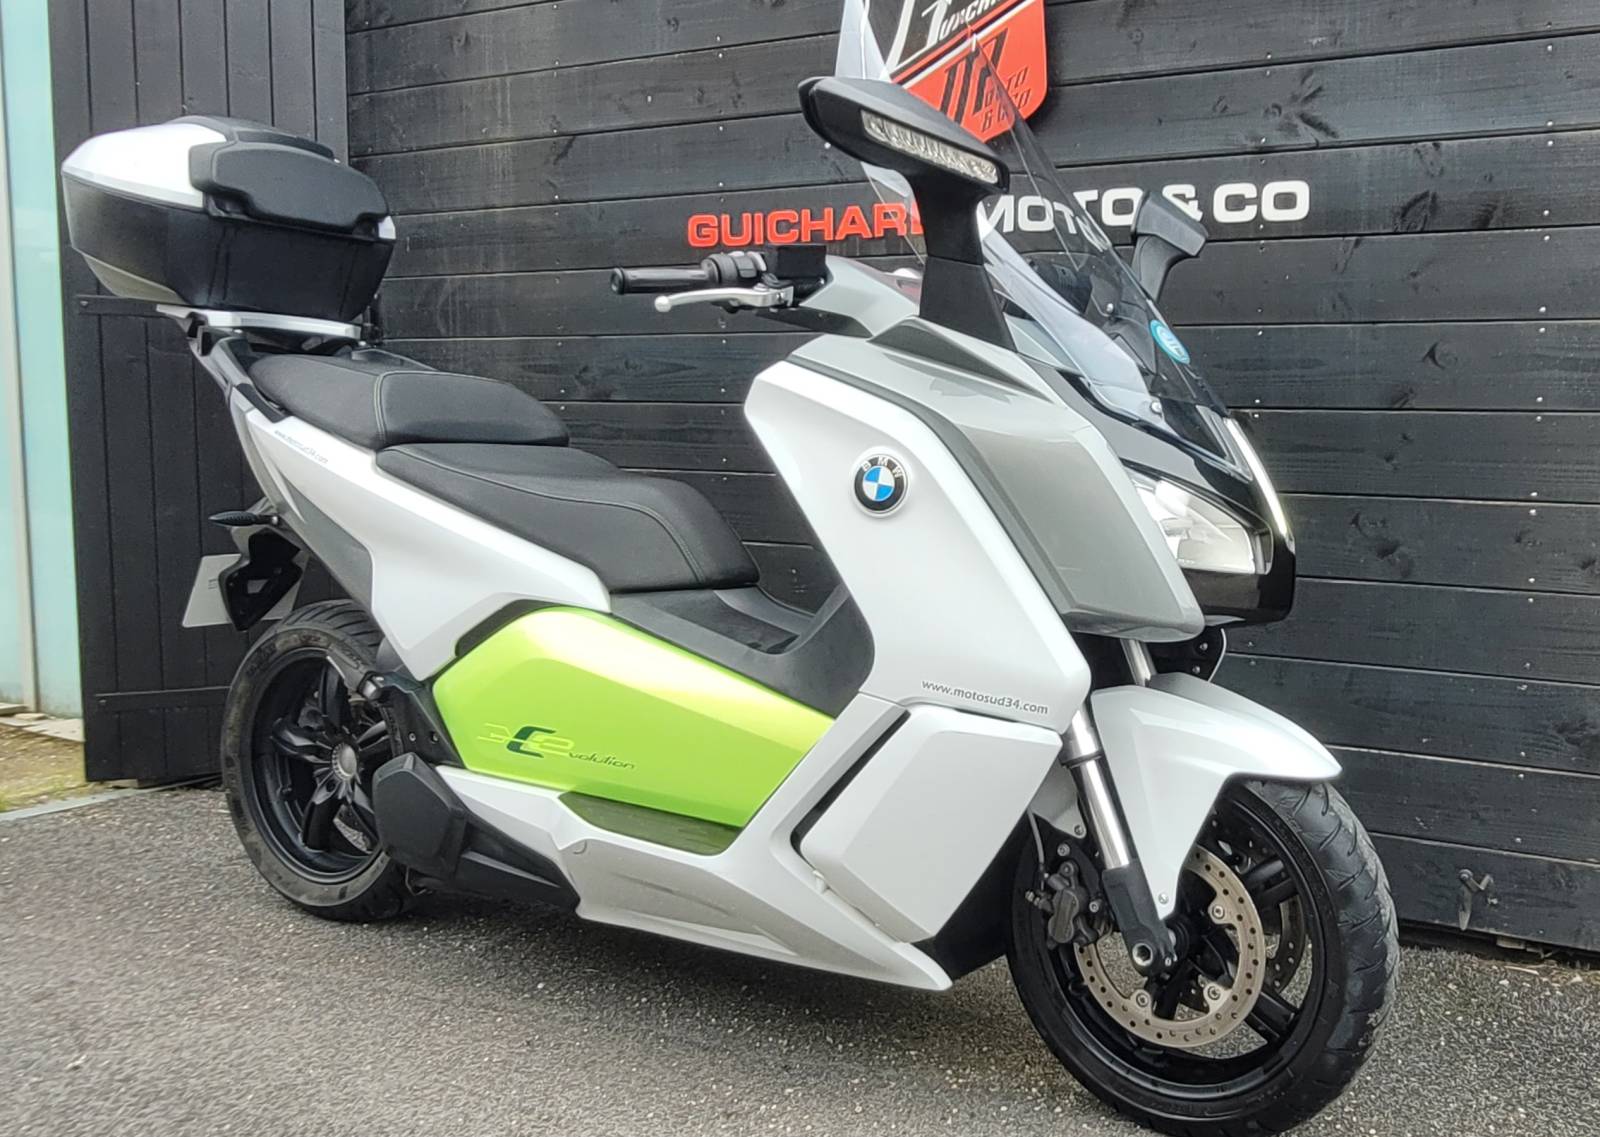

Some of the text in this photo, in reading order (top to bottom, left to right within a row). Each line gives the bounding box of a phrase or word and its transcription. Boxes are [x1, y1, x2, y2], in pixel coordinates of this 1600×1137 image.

[1212, 180, 1311, 223] CO
[861, 455, 904, 479] BMW
[921, 680, 1049, 715] www.motosud34.com
